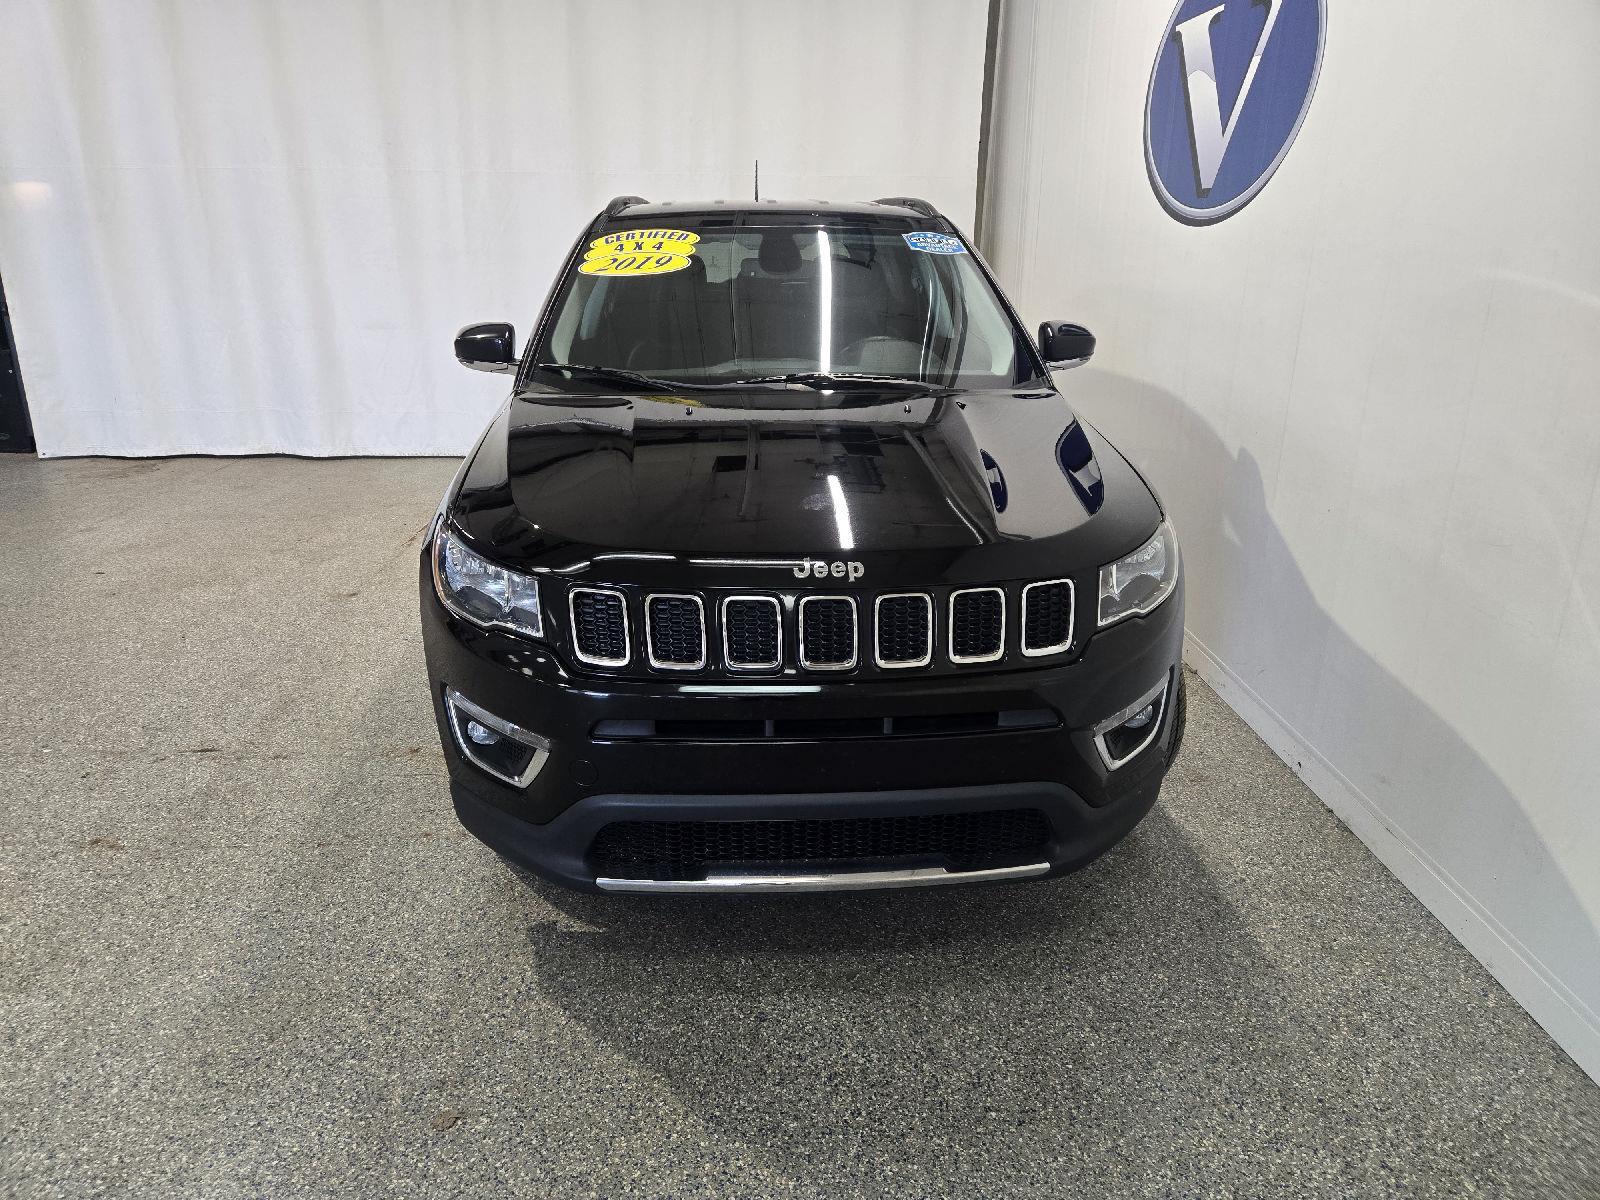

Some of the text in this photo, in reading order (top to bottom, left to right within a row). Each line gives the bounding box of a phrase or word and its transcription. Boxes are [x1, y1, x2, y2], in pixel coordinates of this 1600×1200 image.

[1175, 0, 1282, 190] V
[604, 231, 690, 245] CERTIFIED
[614, 241, 664, 252] 4 X 4
[595, 255, 673, 272] 2019
[793, 556, 865, 583] Jeep
